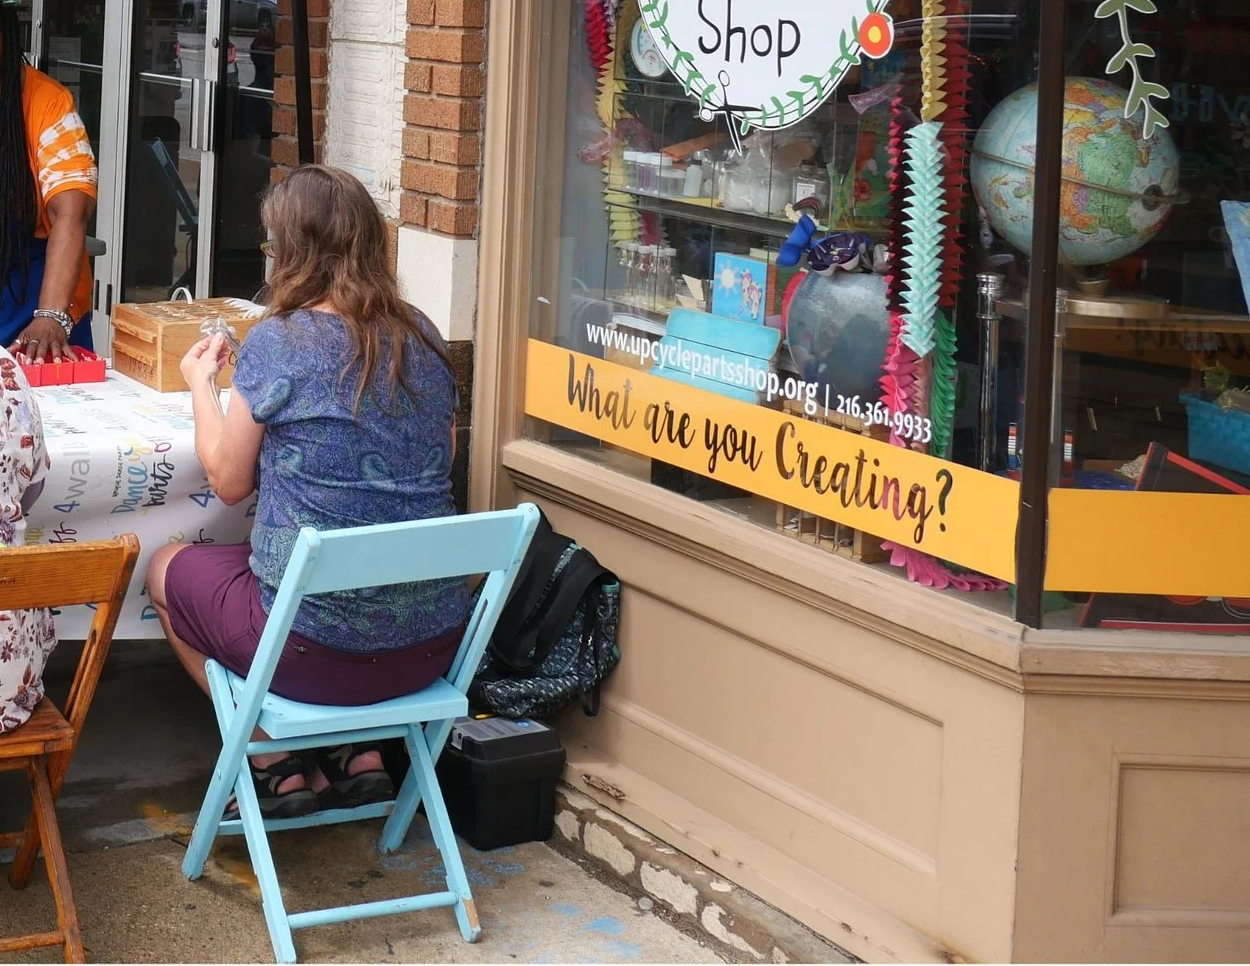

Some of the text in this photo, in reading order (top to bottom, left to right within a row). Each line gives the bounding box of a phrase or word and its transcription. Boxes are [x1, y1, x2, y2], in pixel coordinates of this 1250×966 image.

[586, 323, 933, 445] www.upcyclepartsshop.org 216.361.9933
[110, 461, 148, 514] Dance
[567, 353, 954, 545] What are you Creating?
